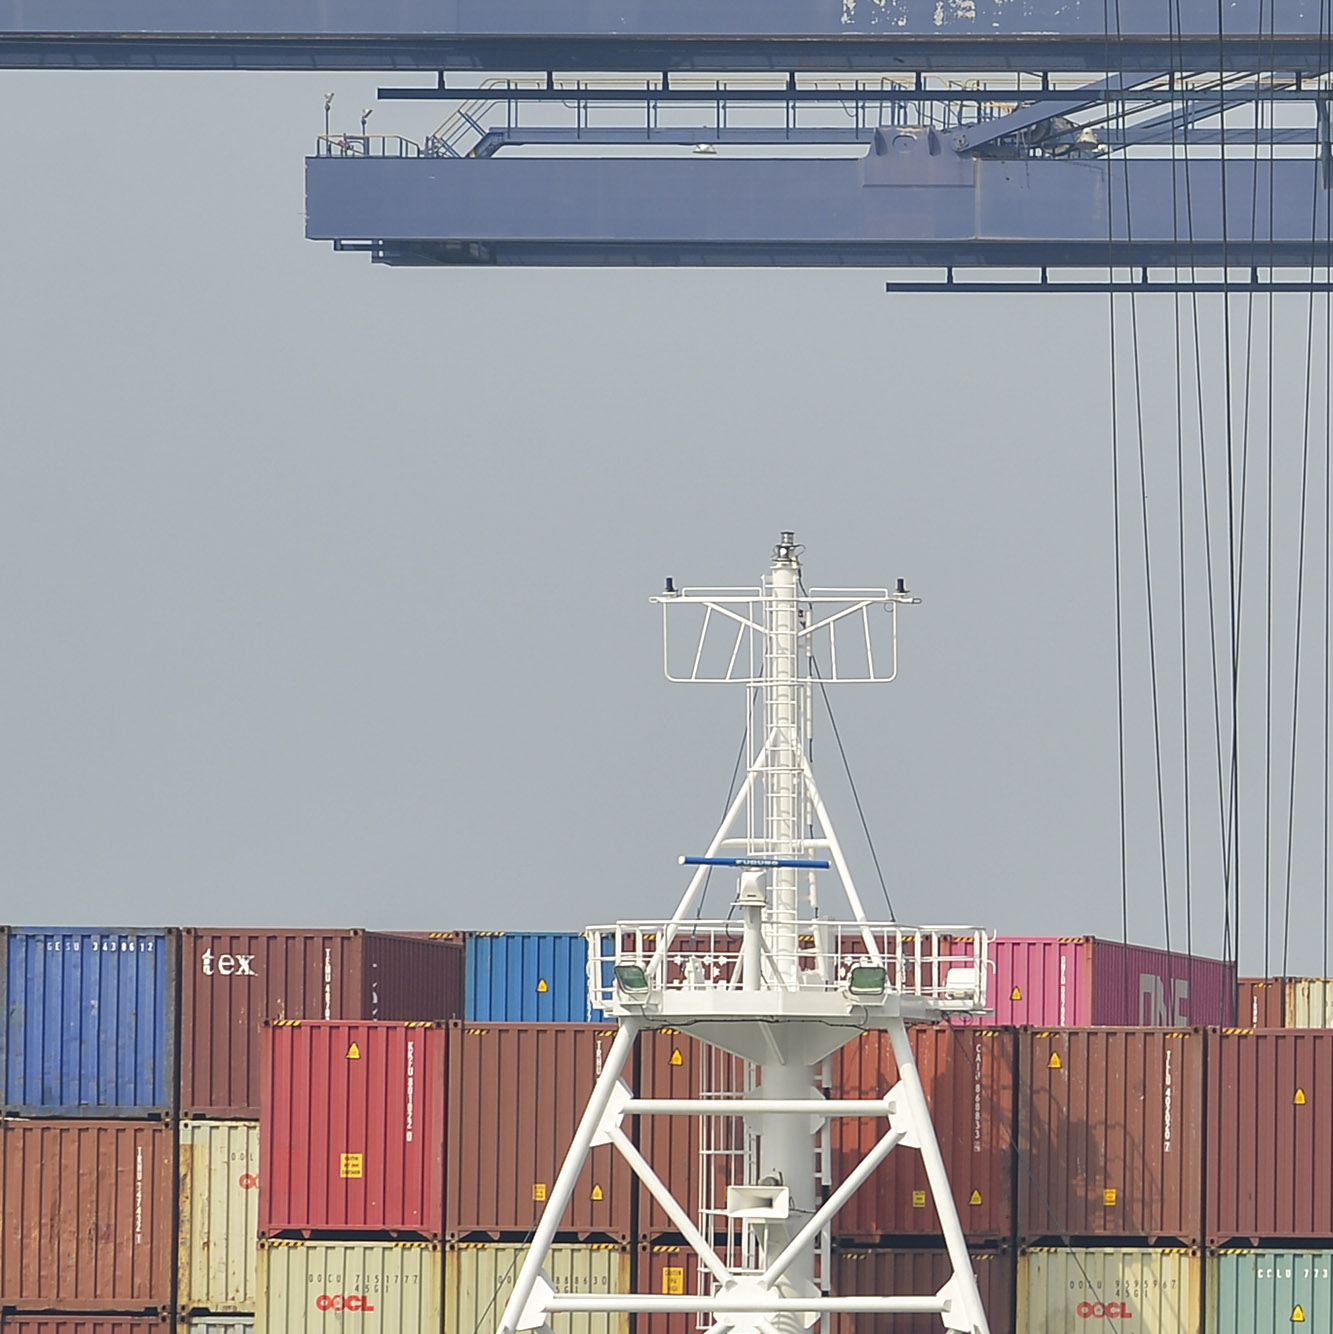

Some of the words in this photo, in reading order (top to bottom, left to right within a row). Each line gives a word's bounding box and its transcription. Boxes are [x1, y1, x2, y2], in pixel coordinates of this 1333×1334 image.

[201, 948, 256, 976] tex
[316, 1294, 375, 1312] OOCL
[1076, 1301, 1132, 1319] OOCL
